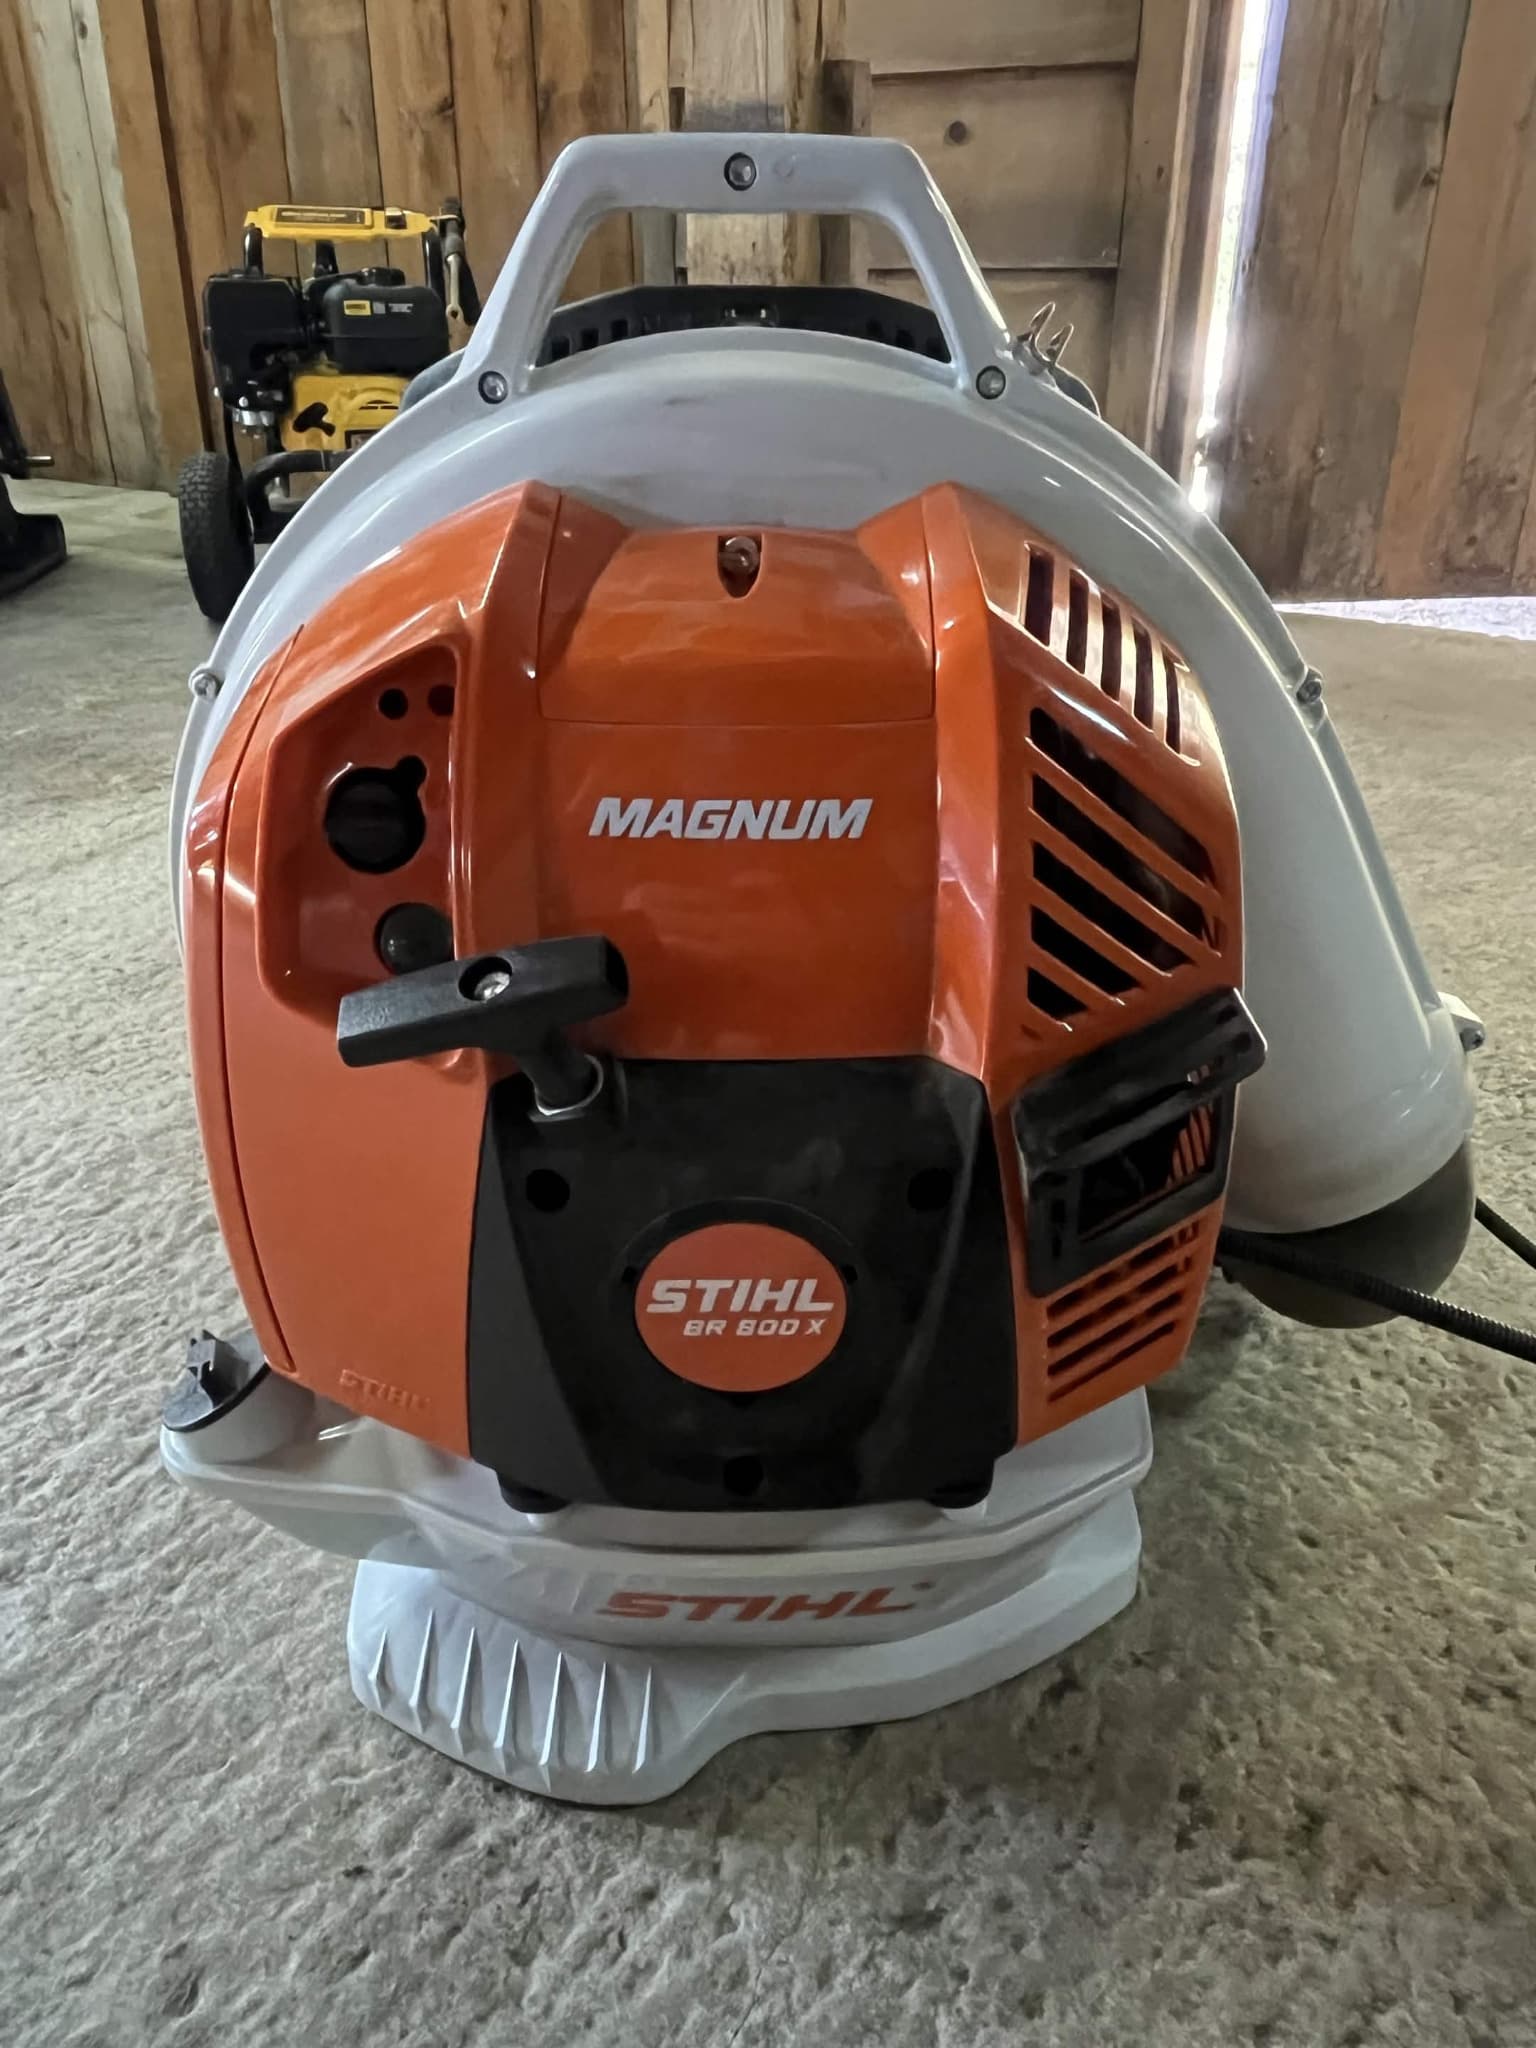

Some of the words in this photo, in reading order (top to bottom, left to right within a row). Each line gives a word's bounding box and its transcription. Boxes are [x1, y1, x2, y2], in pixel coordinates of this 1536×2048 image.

[588, 797, 873, 840] MAGNUM
[646, 1278, 834, 1313] STIHL
[683, 1319, 727, 1336] BR
[736, 1319, 800, 1336] 800
[805, 1318, 827, 1336] X
[596, 1587, 915, 1622] STIHL
